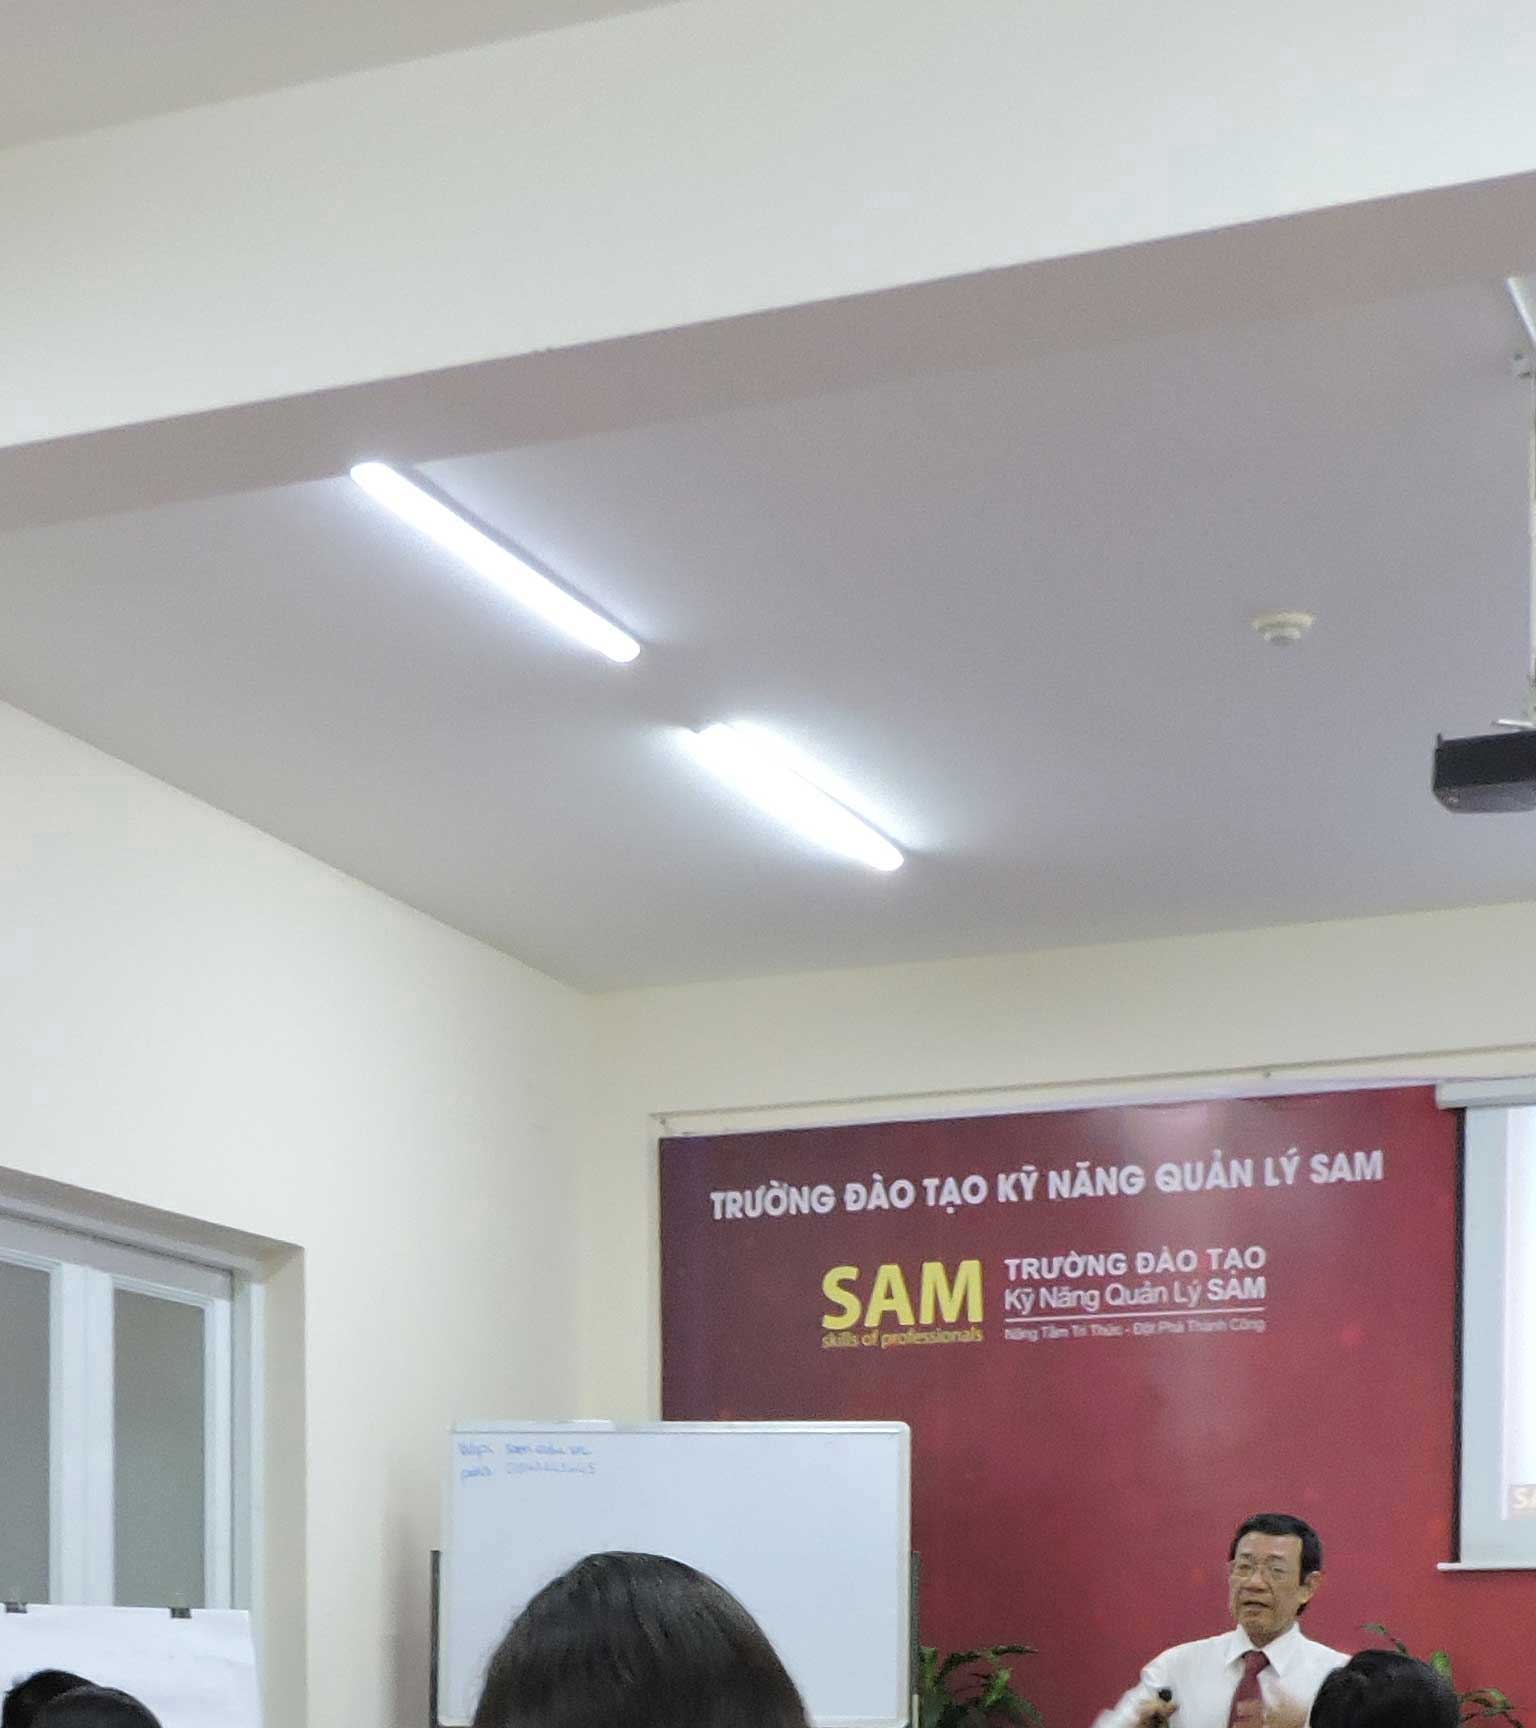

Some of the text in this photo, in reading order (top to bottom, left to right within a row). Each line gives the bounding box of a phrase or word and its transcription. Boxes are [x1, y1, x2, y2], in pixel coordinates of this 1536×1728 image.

[710, 1147, 1384, 1220] TRƯỜNG ĐÀO TẠO KỸ NĂNG QUẢN LÝ SAM
[1004, 1245, 1266, 1281] TRƯỜNG ĐÀO TẠO
[822, 1259, 984, 1330] SAM
[1004, 1277, 1266, 1315] Kỹ Năng Quản Lý SAM
